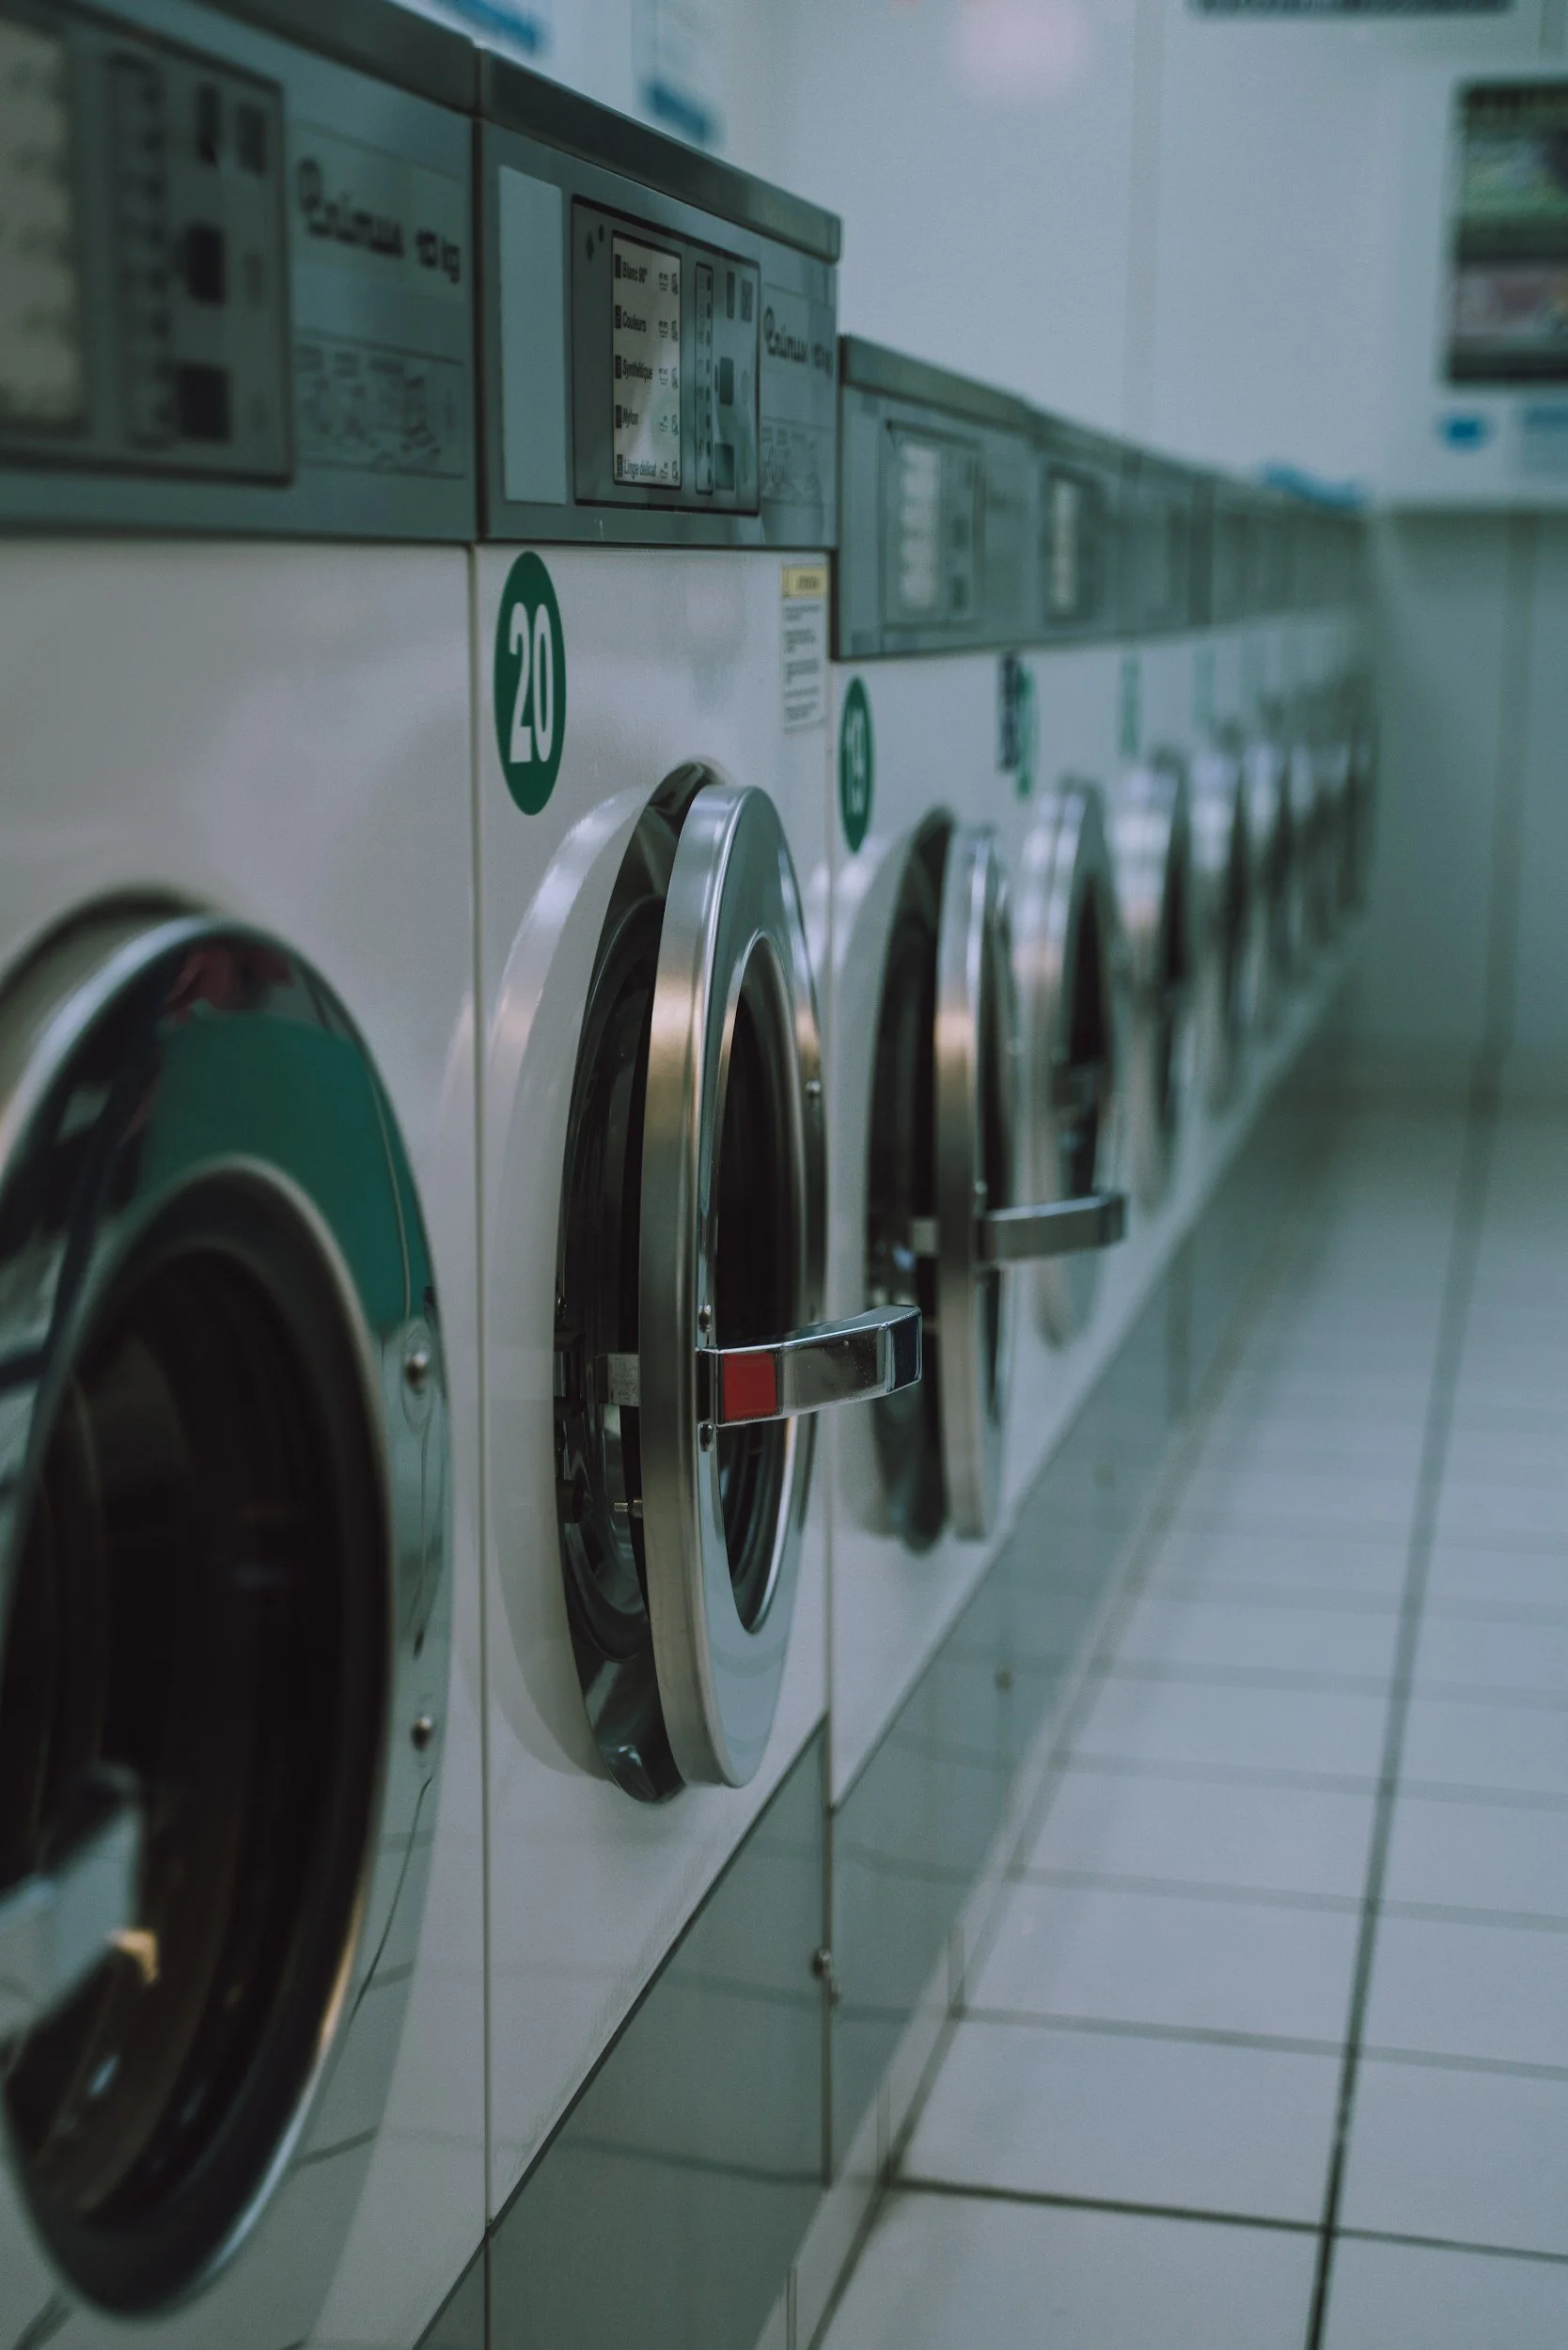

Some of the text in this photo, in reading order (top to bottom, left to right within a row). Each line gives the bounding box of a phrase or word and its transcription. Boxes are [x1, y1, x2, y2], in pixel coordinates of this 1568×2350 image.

[622, 260, 638, 282] Blanc
[622, 310, 646, 333] Couleurs
[622, 358, 653, 384] Synthétique
[622, 407, 639, 429] Nylon
[624, 458, 639, 479] Linge
[508, 601, 555, 764] 20
